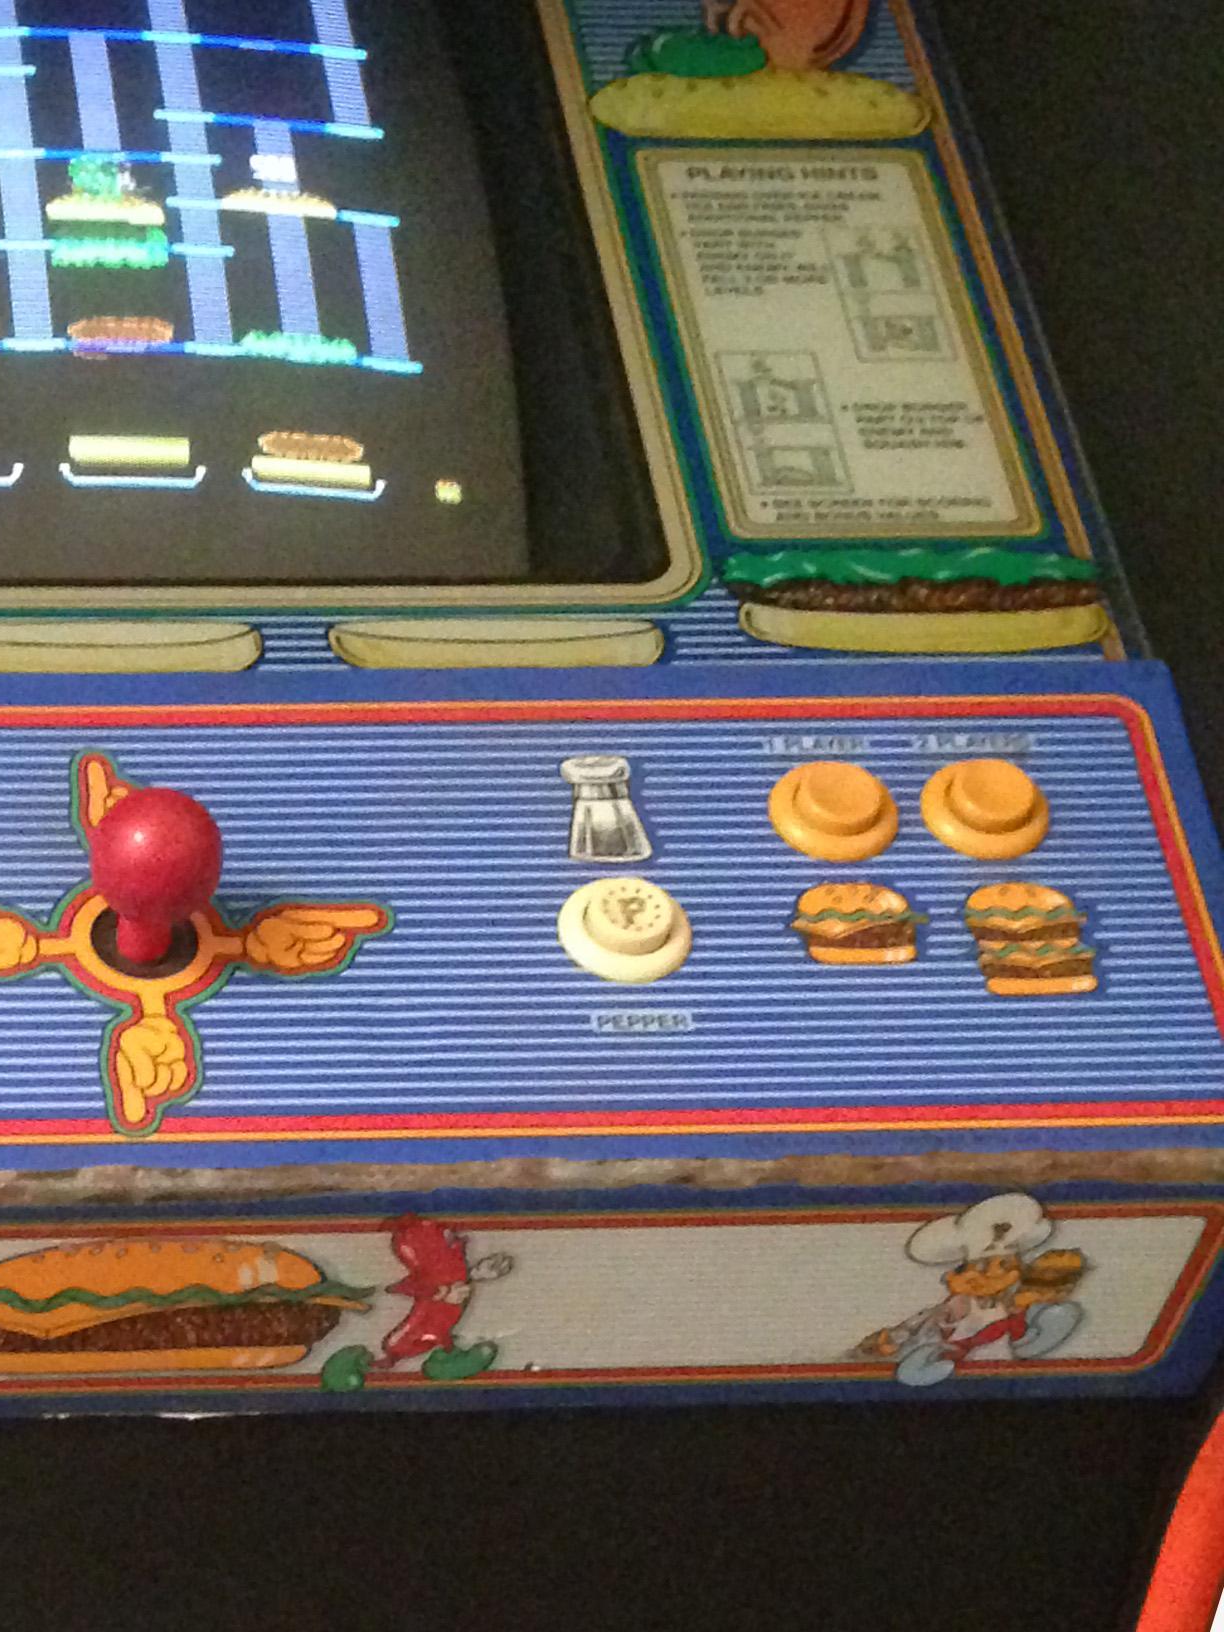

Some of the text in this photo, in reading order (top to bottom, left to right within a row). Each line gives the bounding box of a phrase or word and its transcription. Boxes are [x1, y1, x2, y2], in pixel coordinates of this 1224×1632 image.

[686, 166, 879, 181] PLAYING HINTS
[596, 1014, 688, 1030] PEPPER
